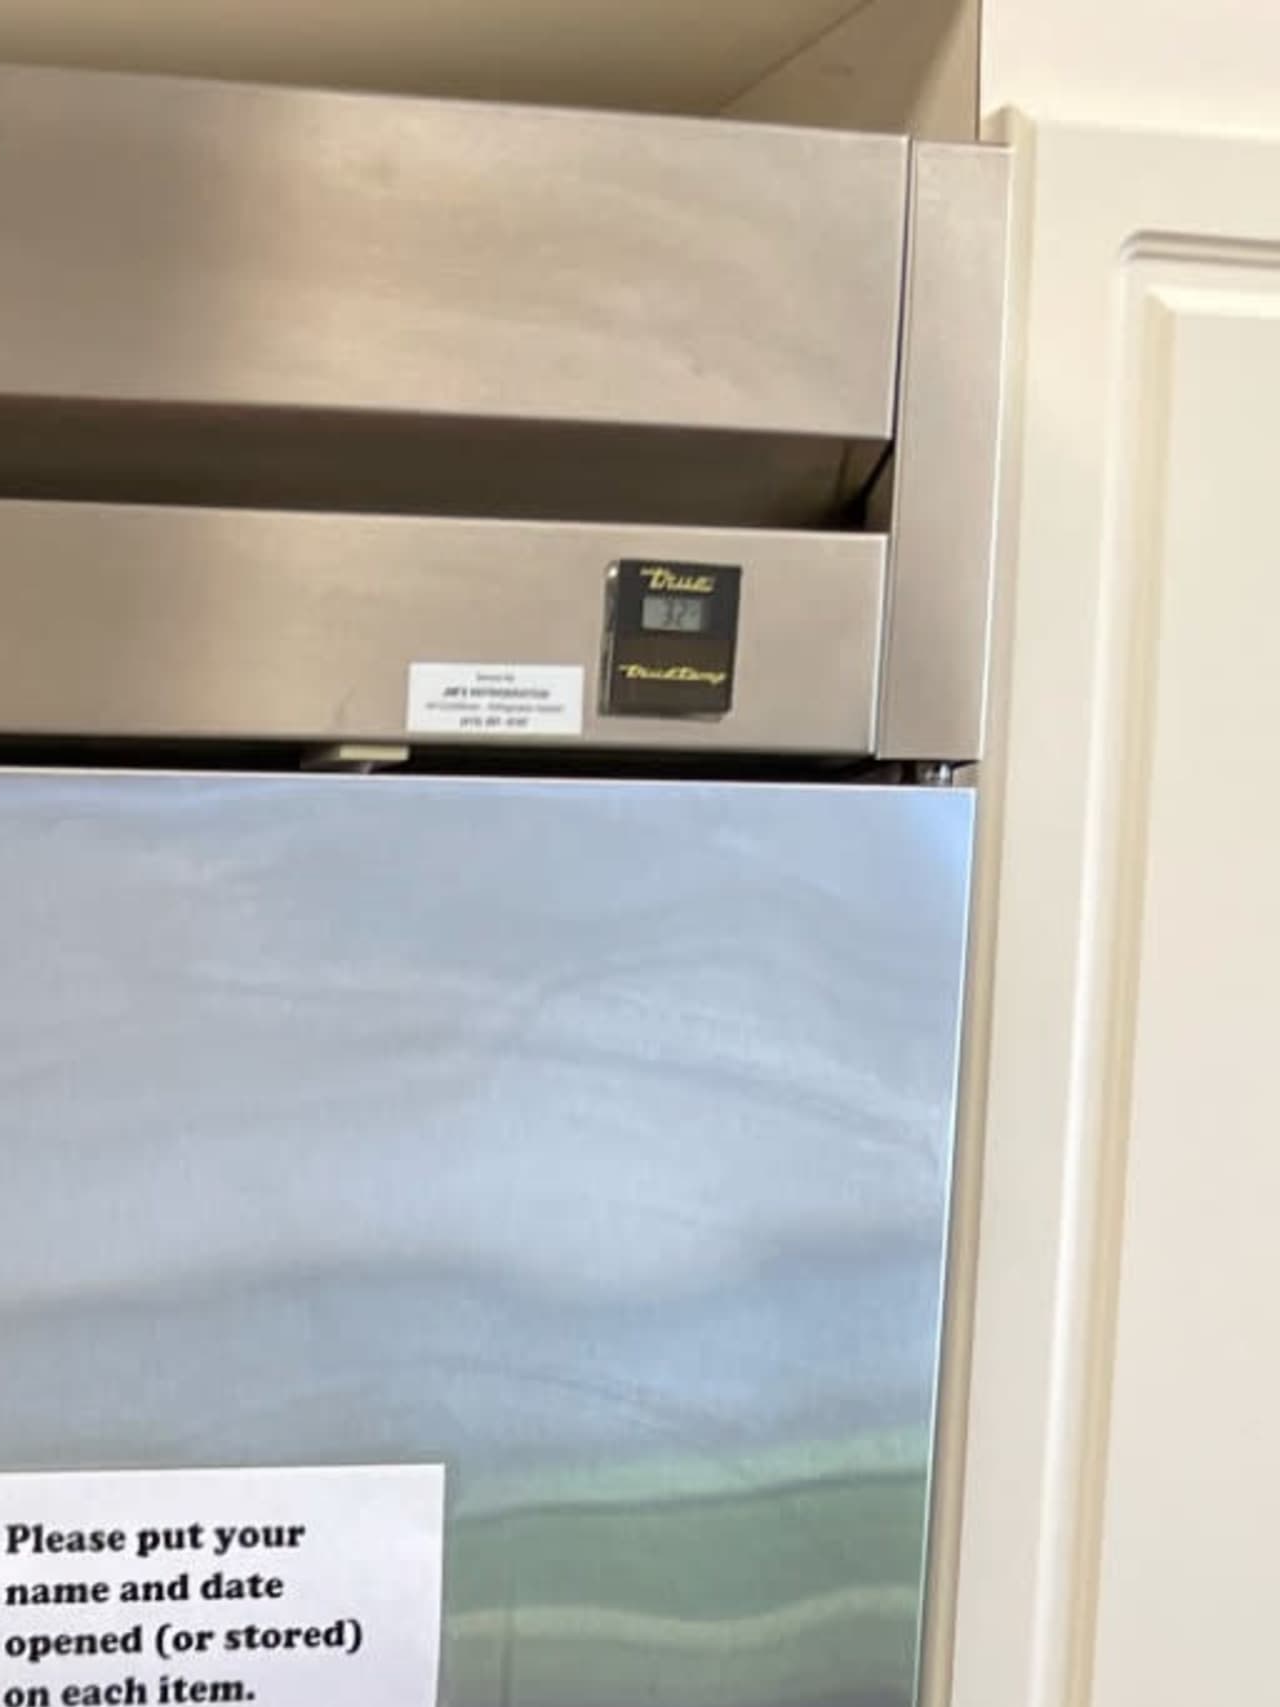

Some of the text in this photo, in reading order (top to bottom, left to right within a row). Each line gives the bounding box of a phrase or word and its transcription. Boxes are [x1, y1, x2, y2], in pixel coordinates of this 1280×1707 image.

[6, 1523, 306, 1559] Please put your
[5, 1571, 284, 1606] name and date
[4, 1618, 363, 1664] opened (or stored)
[60, 1676, 148, 1707] each
[157, 1674, 255, 1705] item.
